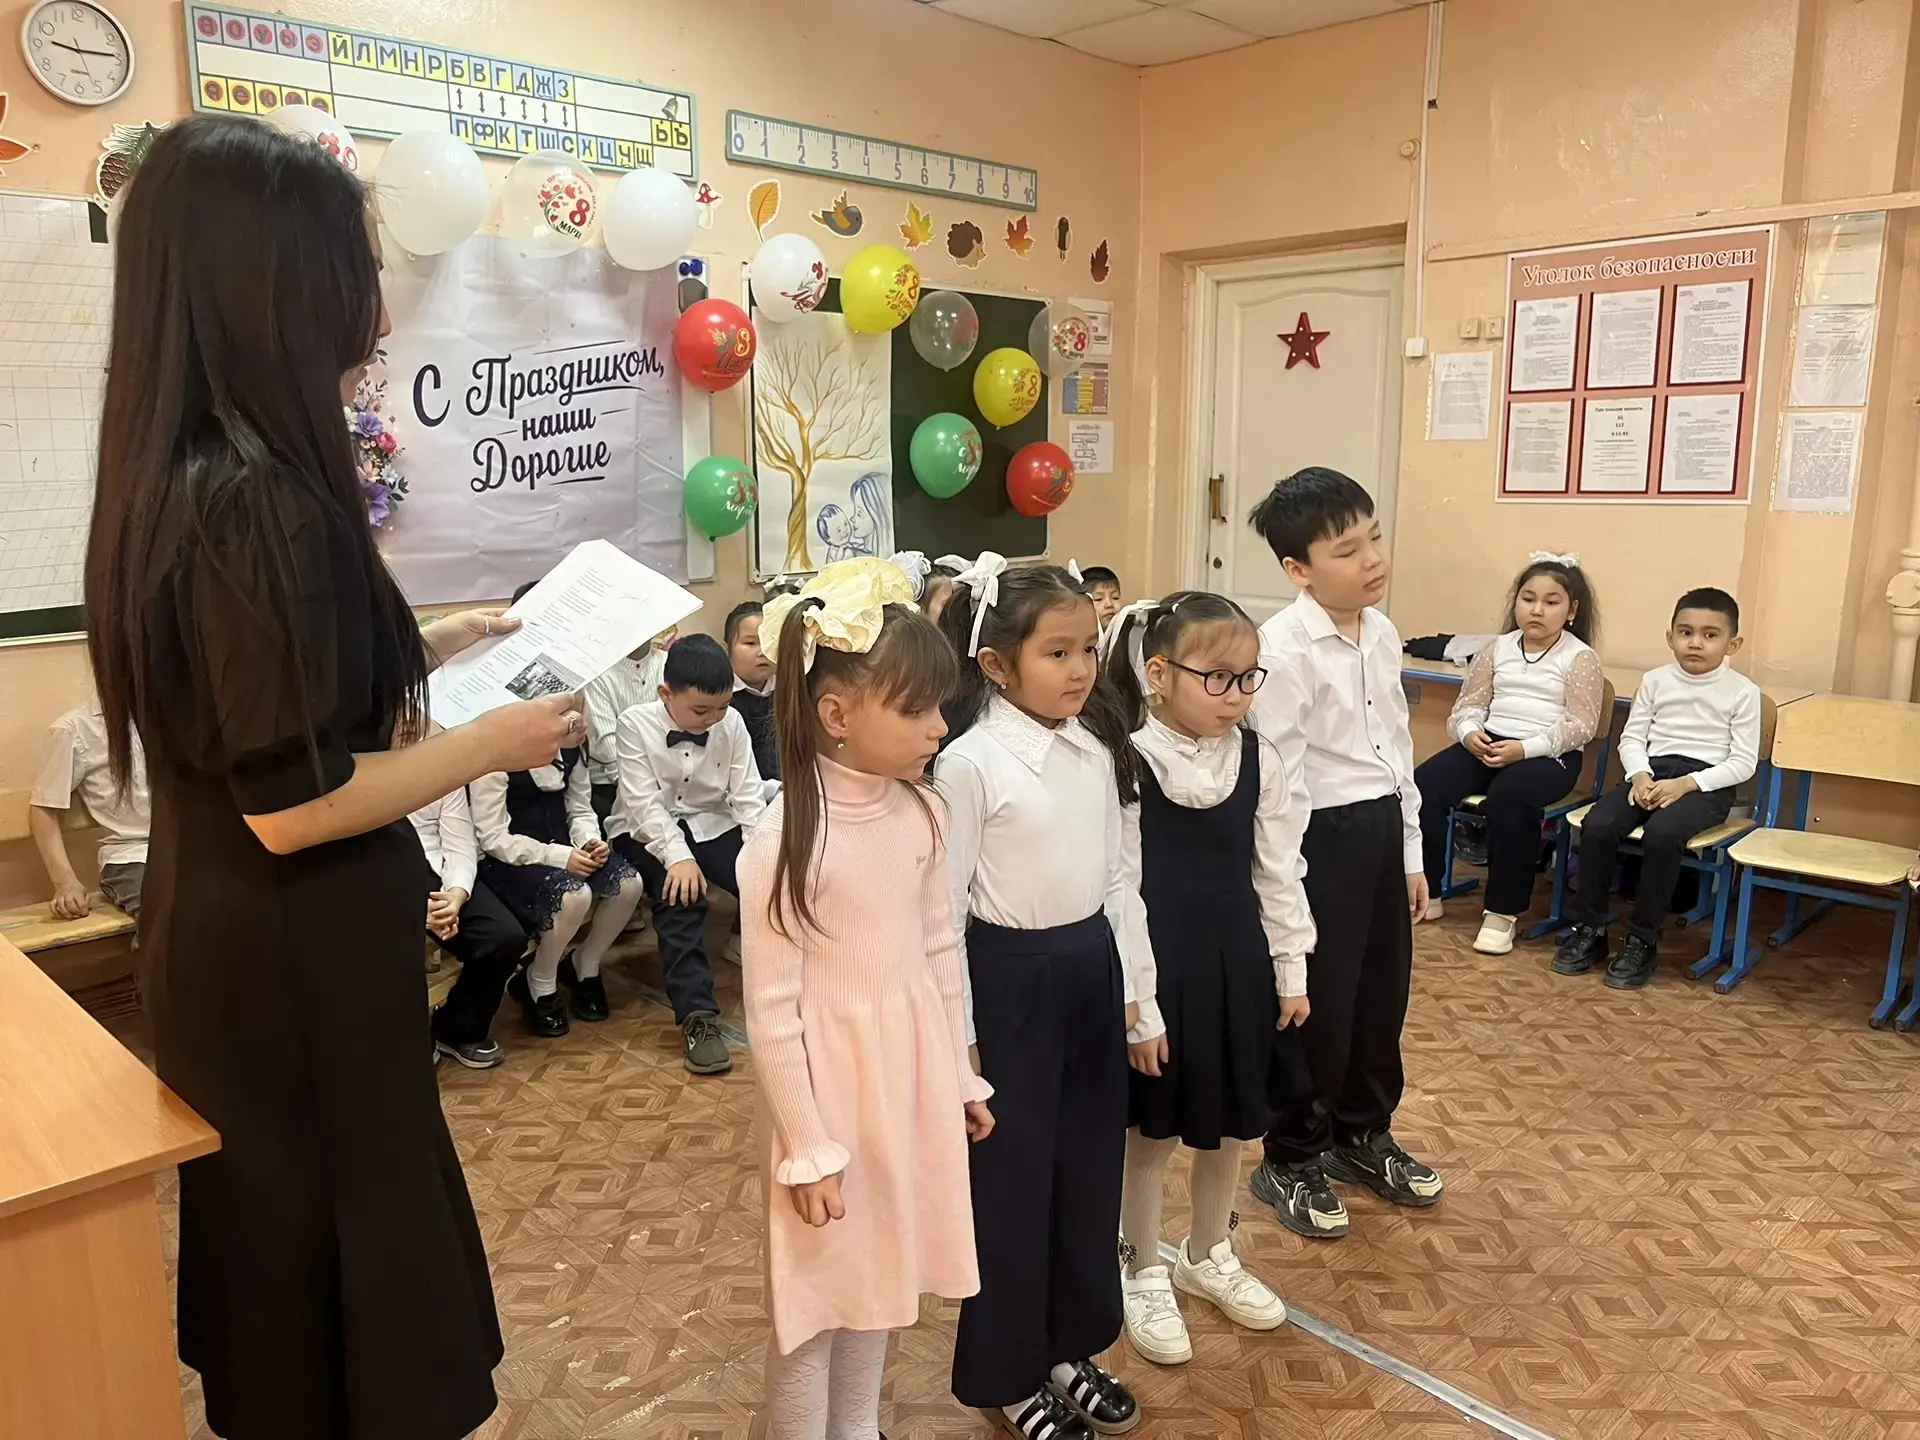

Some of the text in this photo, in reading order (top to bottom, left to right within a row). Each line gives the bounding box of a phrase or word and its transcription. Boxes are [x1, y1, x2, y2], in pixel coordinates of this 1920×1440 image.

[54, 9, 65, 24] 11
[71, 8, 85, 23] 12
[94, 15, 100, 30] 1
[38, 20, 55, 36] 10
[33, 38, 43, 52] 9
[105, 33, 116, 47] 2
[41, 57, 52, 71] 8
[114, 52, 123, 66] 3
[332, 34, 349, 59] Й
[357, 42, 372, 62] Л
[379, 45, 398, 68] М
[404, 50, 419, 72] Н
[428, 55, 442, 75] Р
[451, 59, 465, 79] Б
[473, 63, 486, 83] В
[496, 68, 507, 86] Г
[516, 72, 530, 93] Д
[536, 75, 551, 96] Ж
[558, 79, 569, 98] З
[57, 72, 67, 87] 7
[106, 70, 116, 83] 4
[75, 82, 85, 95] 6
[93, 80, 103, 94] 5
[655, 122, 688, 146] Ь Ъ
[456, 119, 651, 167] П Ф К Т Ш С Х Ц Ч Щ
[733, 132, 1035, 203] 0 1 2 3 4 5 6 7 8 9 10
[569, 198, 590, 227] 8
[1523, 247, 1757, 287] Уголок безопасности
[734, 327, 750, 357] 8
[1074, 332, 1086, 351] 8
[412, 346, 665, 427] С Праздником,
[1028, 375, 1038, 397] 8
[522, 407, 596, 441] наши
[470, 437, 612, 493] Дорогие
